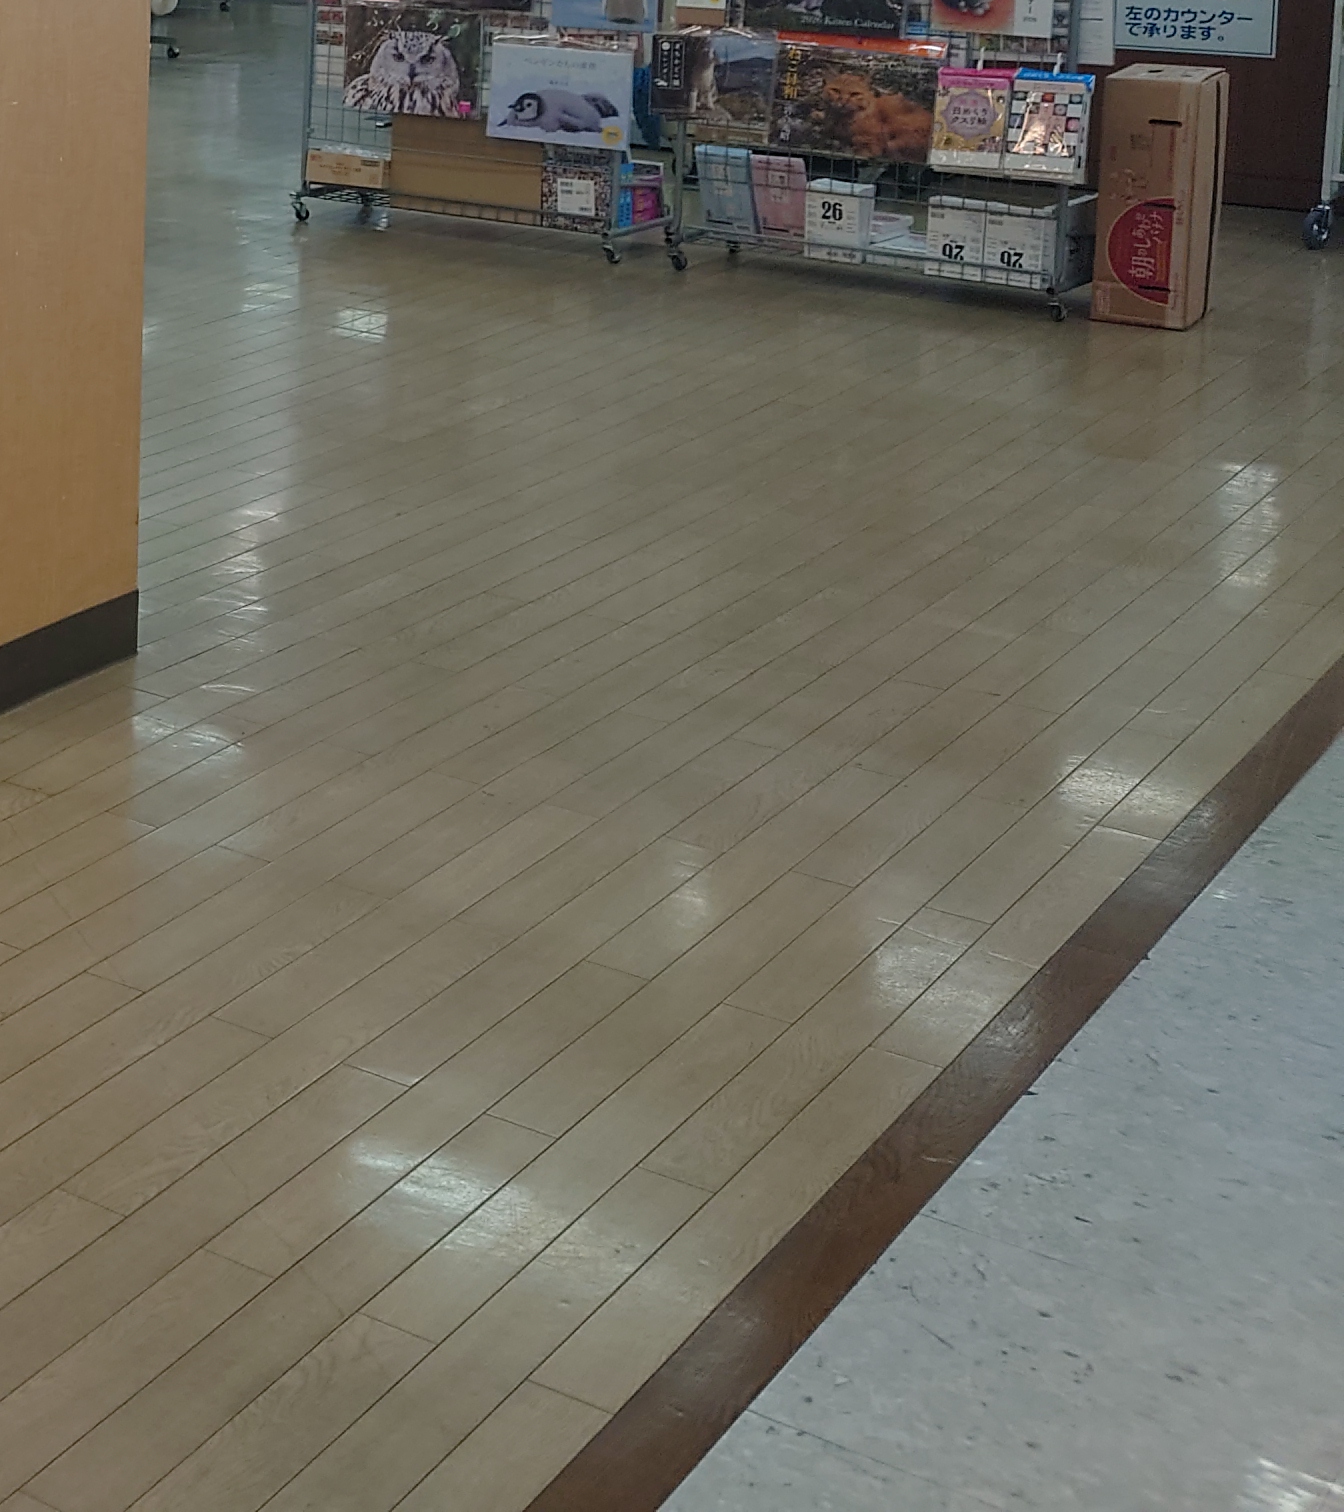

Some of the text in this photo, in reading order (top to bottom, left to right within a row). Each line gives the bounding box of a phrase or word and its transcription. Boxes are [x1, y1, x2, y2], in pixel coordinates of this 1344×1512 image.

[1125, 6, 1253, 25] 左のカウンター
[1125, 21, 1225, 42] で承ります。
[821, 200, 843, 221] 26
